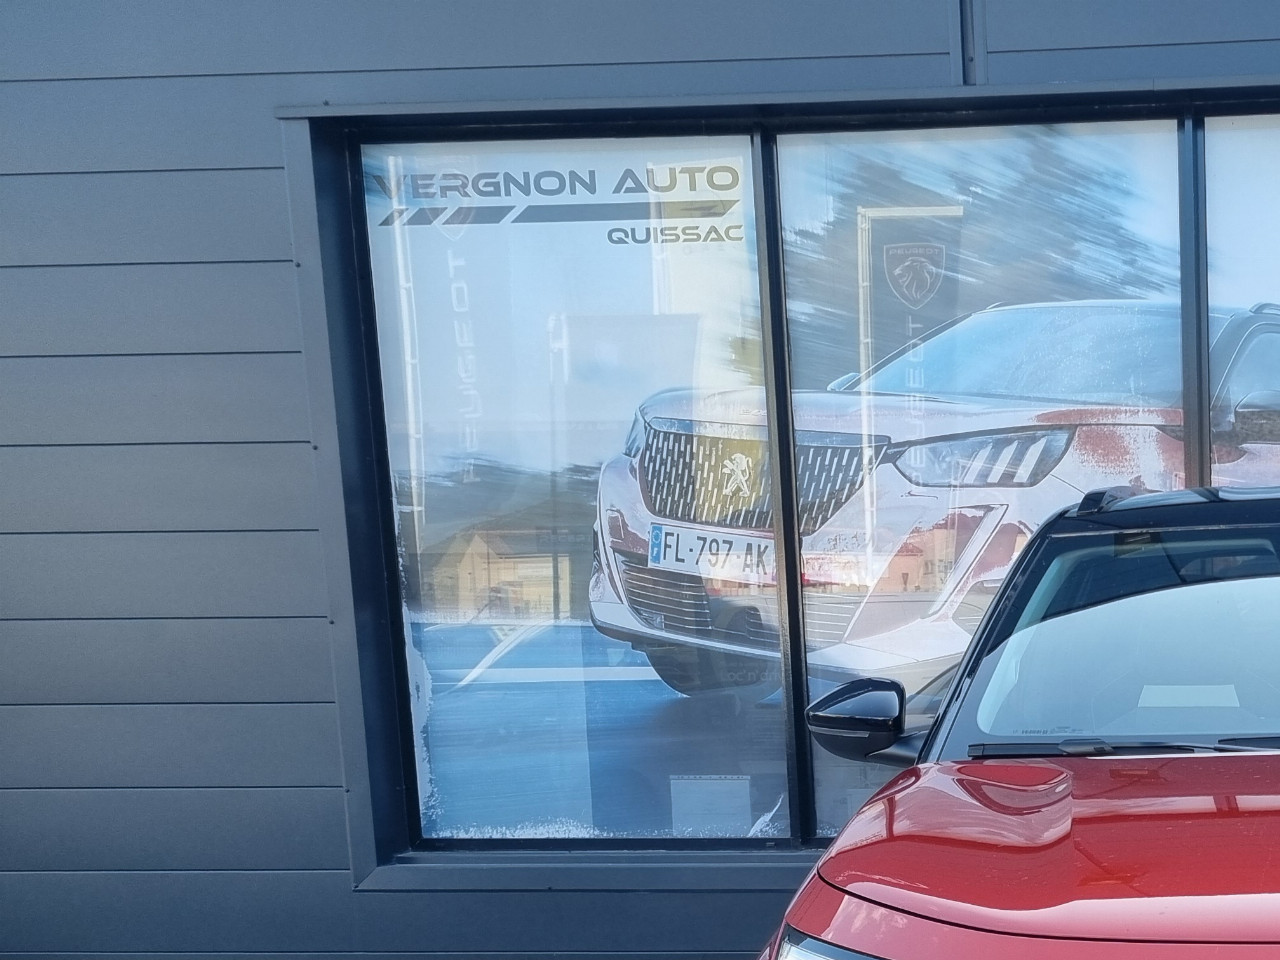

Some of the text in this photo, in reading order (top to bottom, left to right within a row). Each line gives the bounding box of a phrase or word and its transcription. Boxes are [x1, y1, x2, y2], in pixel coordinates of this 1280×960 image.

[373, 166, 740, 199] VERGNON AUTO
[607, 225, 744, 245] QUISSAC
